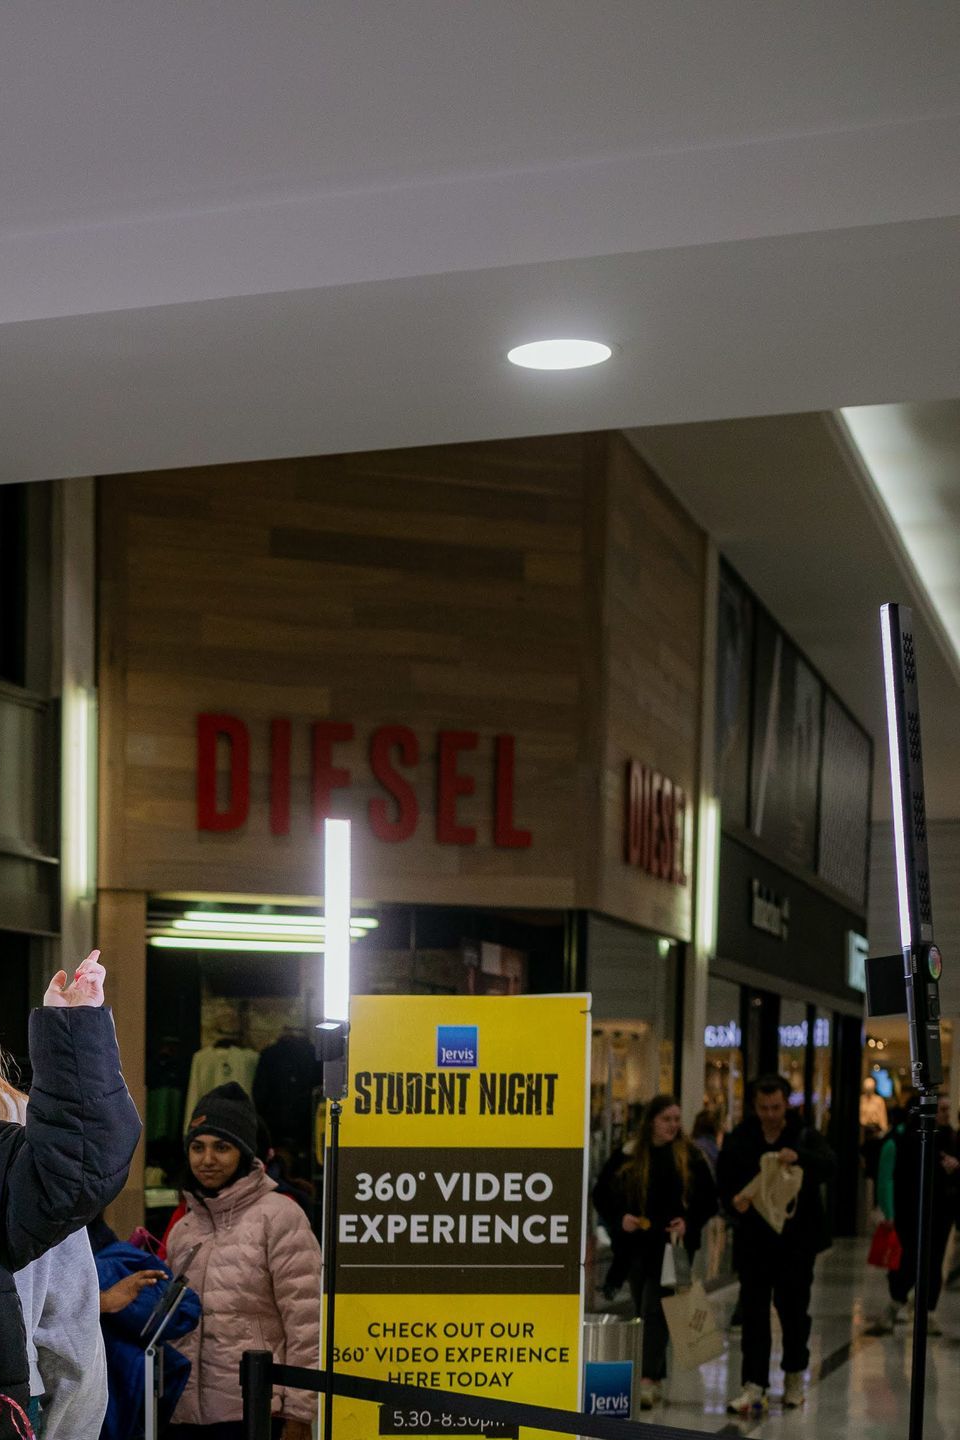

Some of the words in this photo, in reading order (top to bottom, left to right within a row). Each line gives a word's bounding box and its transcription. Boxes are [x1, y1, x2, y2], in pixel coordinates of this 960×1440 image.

[197, 712, 532, 848] DIESEL
[441, 1047, 474, 1063] Jervis
[354, 1071, 470, 1115] STUDENT
[478, 1072, 558, 1116] NIGHT
[433, 1172, 553, 1202] VIDEO
[338, 1214, 569, 1244] EXPERIENCE
[367, 1322, 438, 1338] CHECK
[443, 1322, 485, 1338] OUT
[490, 1322, 535, 1338] OUR
[375, 1347, 439, 1362] VIDEO
[445, 1347, 569, 1363] EXPERIENCE
[388, 1371, 440, 1387] HERE
[446, 1372, 513, 1387] TODAY
[590, 1392, 629, 1415] Jervis
